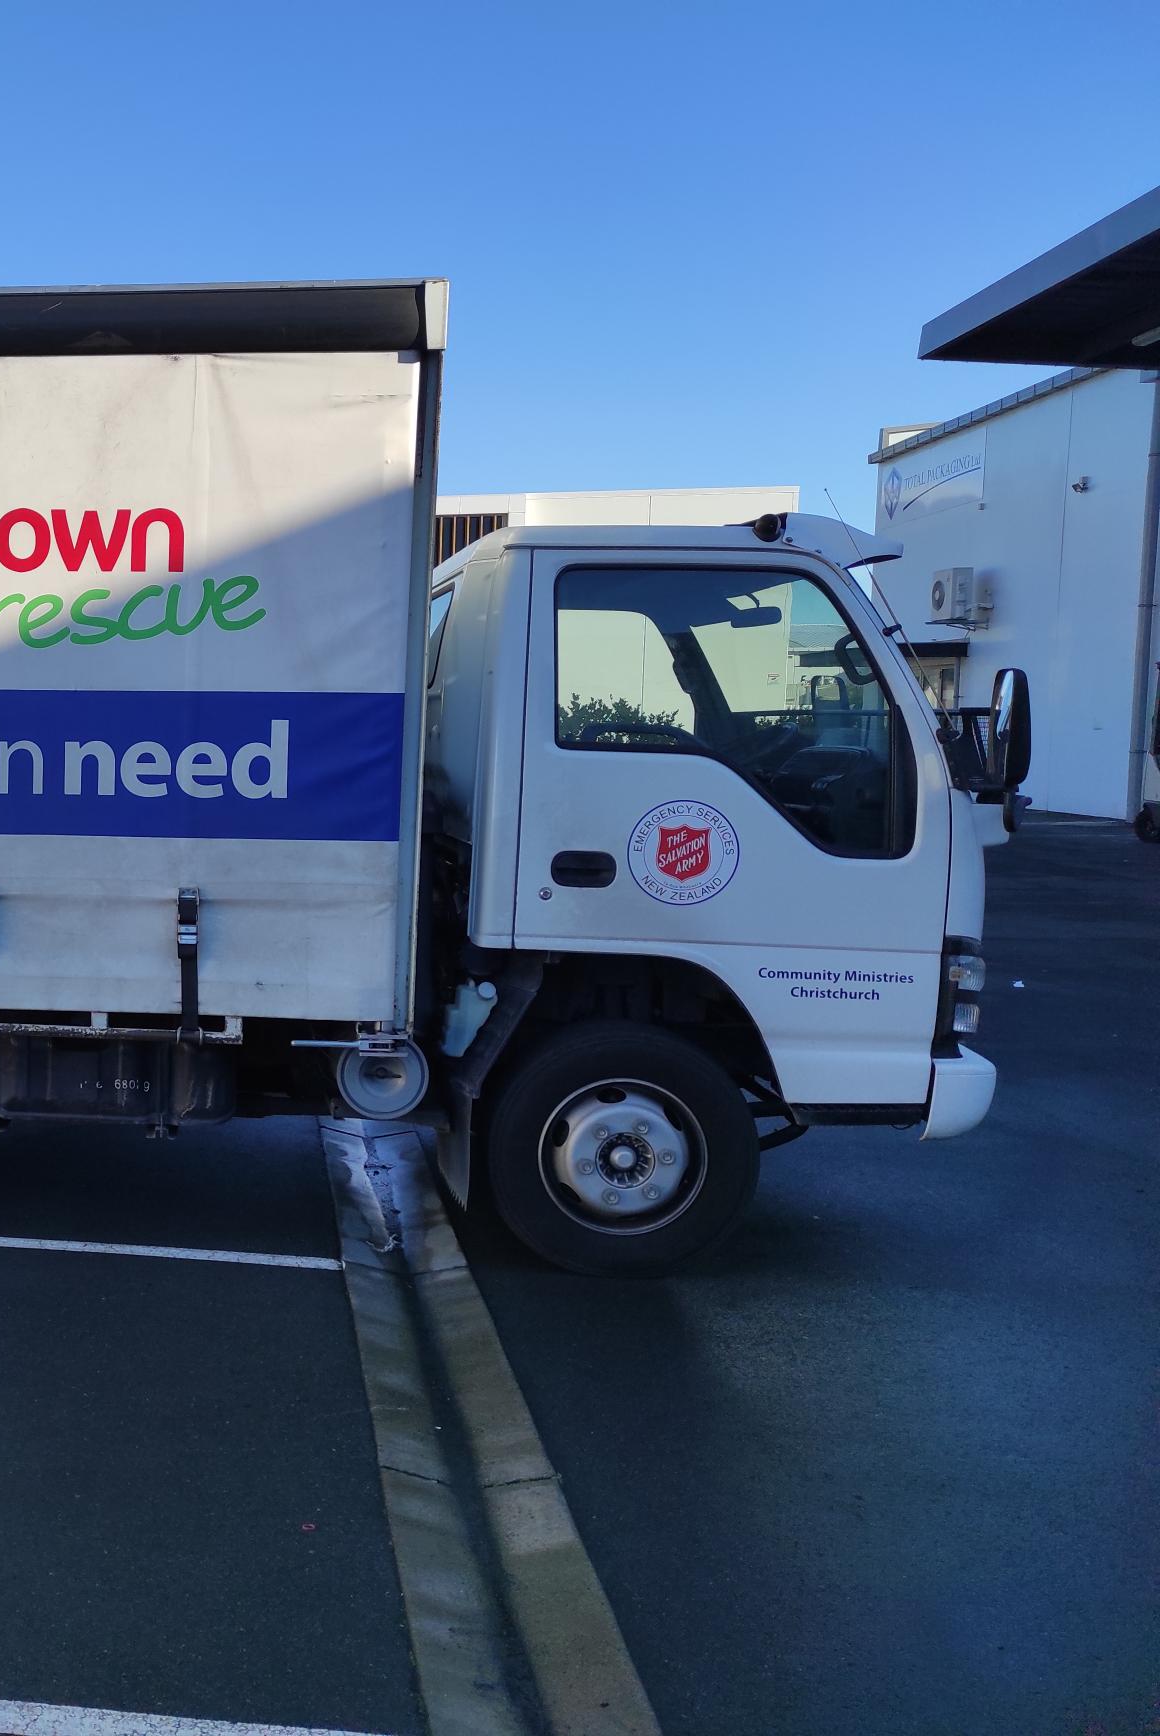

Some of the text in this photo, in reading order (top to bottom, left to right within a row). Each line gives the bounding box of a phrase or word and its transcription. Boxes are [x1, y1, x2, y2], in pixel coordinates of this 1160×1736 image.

[904, 471, 926, 490] TOTAL
[926, 454, 971, 483] PACKAGING
[63, 719, 290, 800] need
[633, 804, 735, 856] EMERGENCY SERVICES
[666, 830, 689, 849] THE
[658, 833, 706, 868] SALVATION
[674, 849, 704, 875] ARMY
[641, 875, 722, 901] NEW ZEALAND
[758, 967, 914, 984] Community Ministries
[790, 986, 880, 1001] Christchurch
